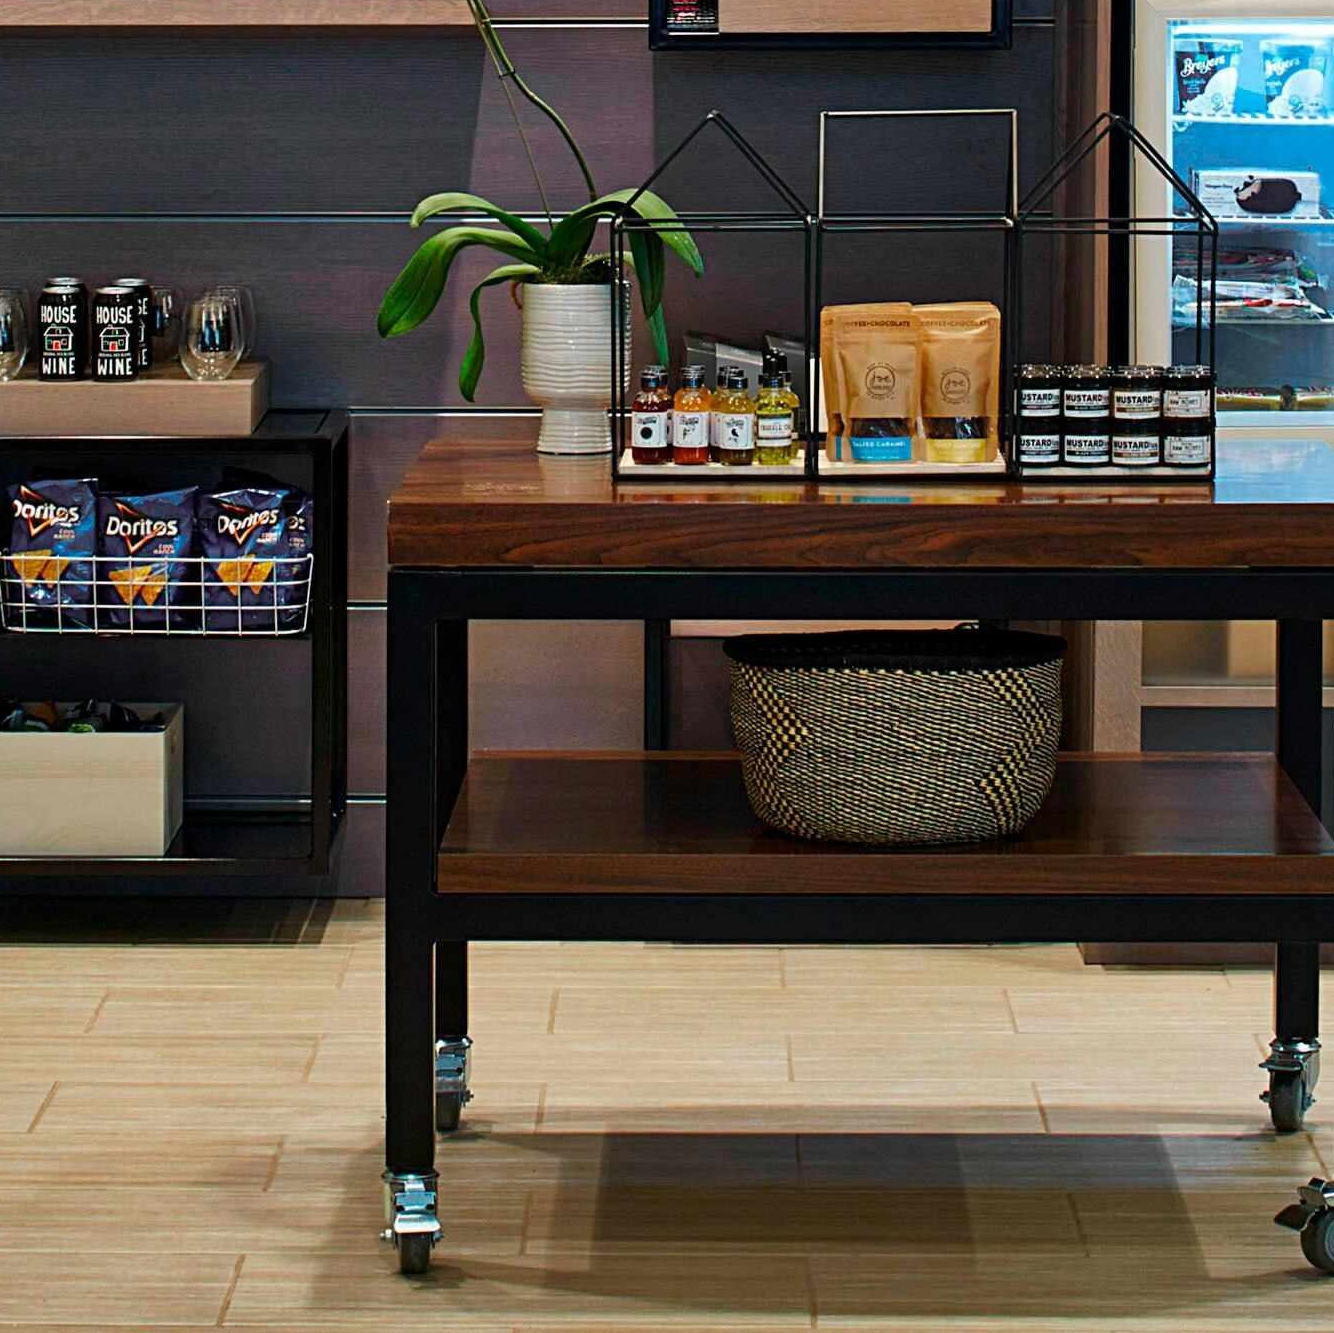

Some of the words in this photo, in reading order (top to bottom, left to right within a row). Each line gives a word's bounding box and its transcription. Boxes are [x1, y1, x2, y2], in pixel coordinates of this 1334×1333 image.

[1180, 55, 1226, 77] Breyers
[40, 305, 77, 324] HOUSE
[96, 305, 134, 324] HOUSE
[42, 357, 76, 375] WINE
[97, 358, 133, 376] WINE
[1021, 393, 1053, 402] USTARD
[1066, 394, 1103, 402] MUSTARD
[1116, 395, 1153, 403] MUSTARD
[1020, 439, 1052, 447] USTARD
[1067, 439, 1103, 448] MUSTARD
[1113, 441, 1149, 449] MUSTARD
[106, 516, 179, 536] Doritos
[217, 509, 280, 535] Doritos
